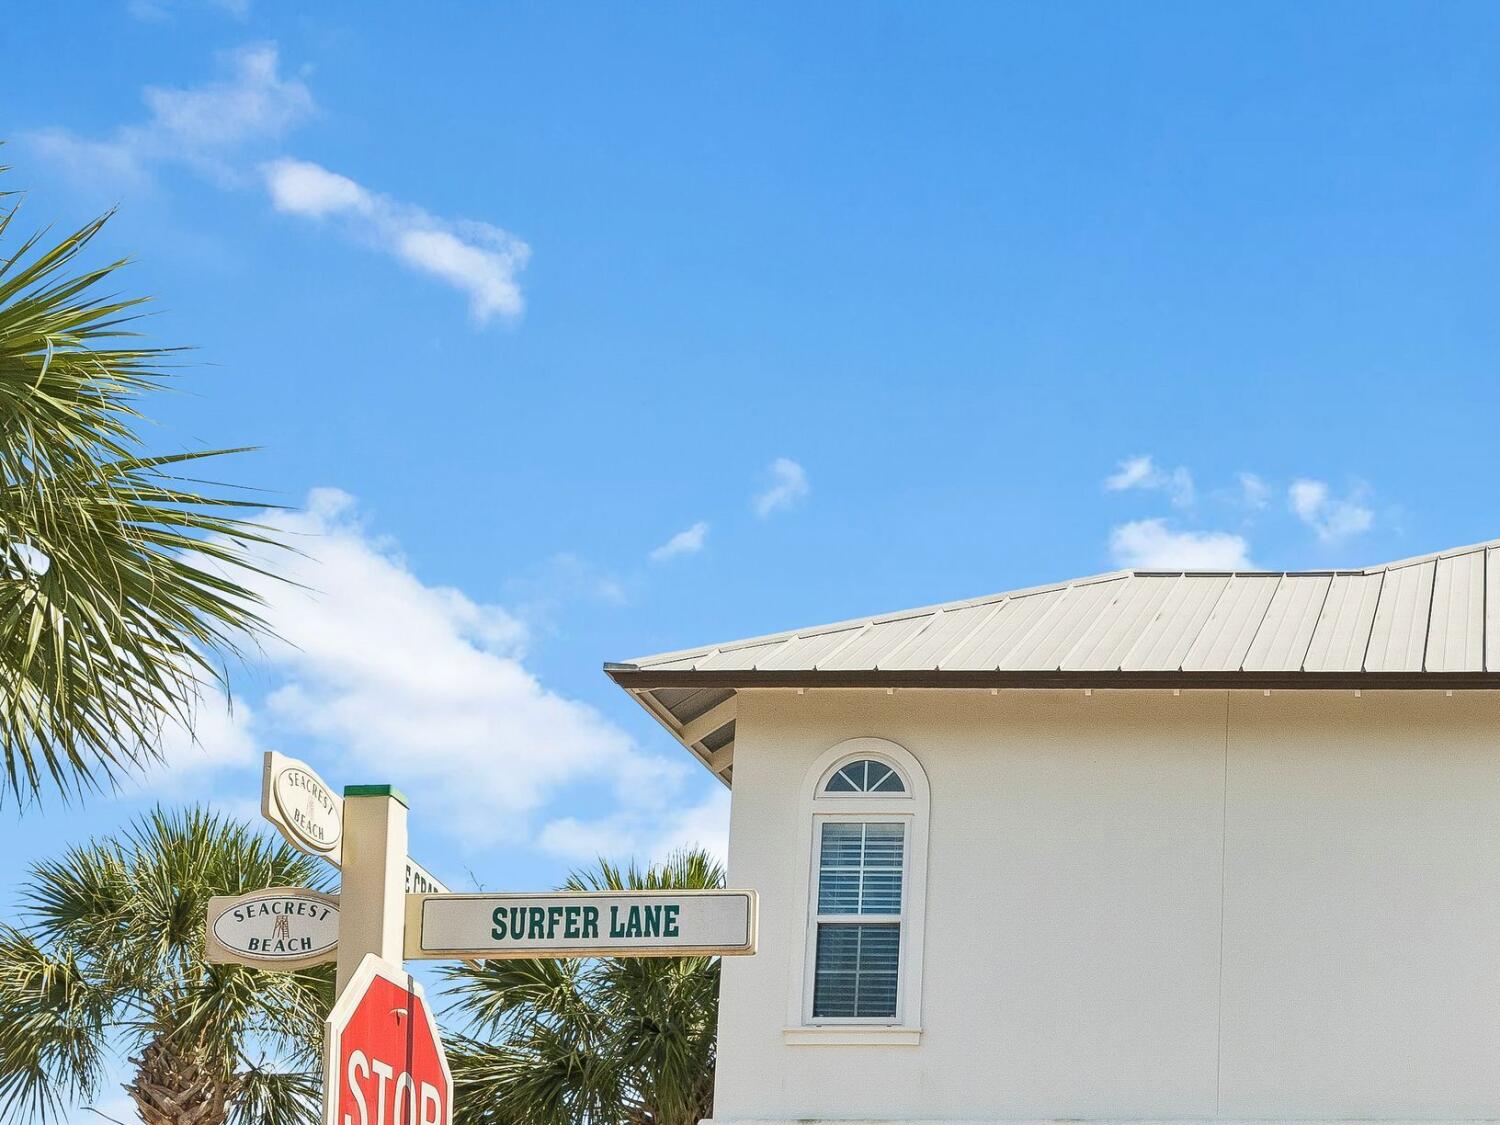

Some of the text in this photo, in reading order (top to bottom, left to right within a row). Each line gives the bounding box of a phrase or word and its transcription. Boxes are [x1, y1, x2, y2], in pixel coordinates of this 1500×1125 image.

[288, 772, 333, 816] SEACREST
[293, 808, 324, 841] BEACH
[233, 901, 331, 923] SEACREST
[491, 904, 680, 940] SURFER LANE
[248, 937, 312, 952] BEACH
